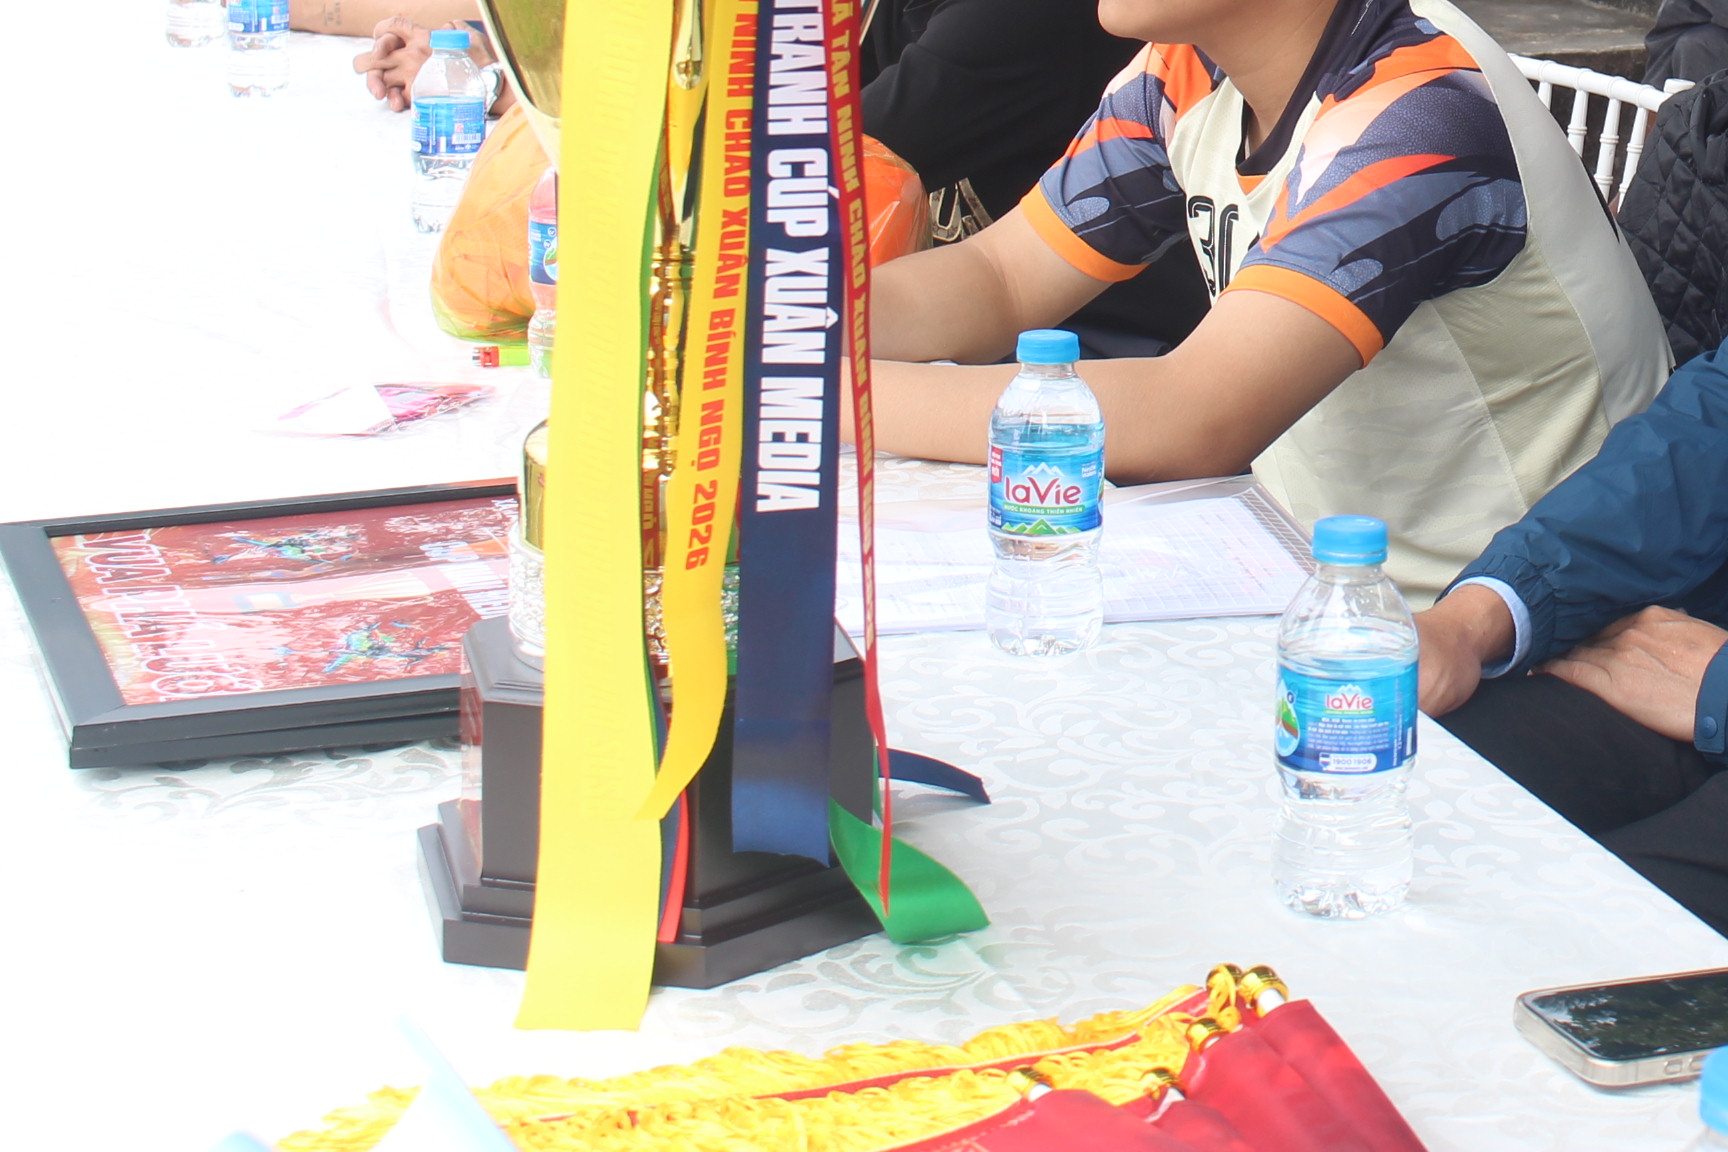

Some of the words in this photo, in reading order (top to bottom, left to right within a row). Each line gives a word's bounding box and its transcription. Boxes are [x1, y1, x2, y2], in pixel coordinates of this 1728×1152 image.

[727, 13, 758, 98] NINH
[836, 104, 861, 193] NINH
[767, 147, 840, 238] CÚP
[711, 207, 750, 299] XUÂN
[761, 246, 839, 365] XUÂN
[702, 308, 737, 391] BÍNH
[691, 398, 725, 472] NGỌ
[756, 376, 825, 513] MEDIA
[685, 479, 719, 571] 2026
[1005, 477, 1082, 505] laVie
[78, 532, 172, 584] VUA
[1326, 693, 1373, 710] laVie
